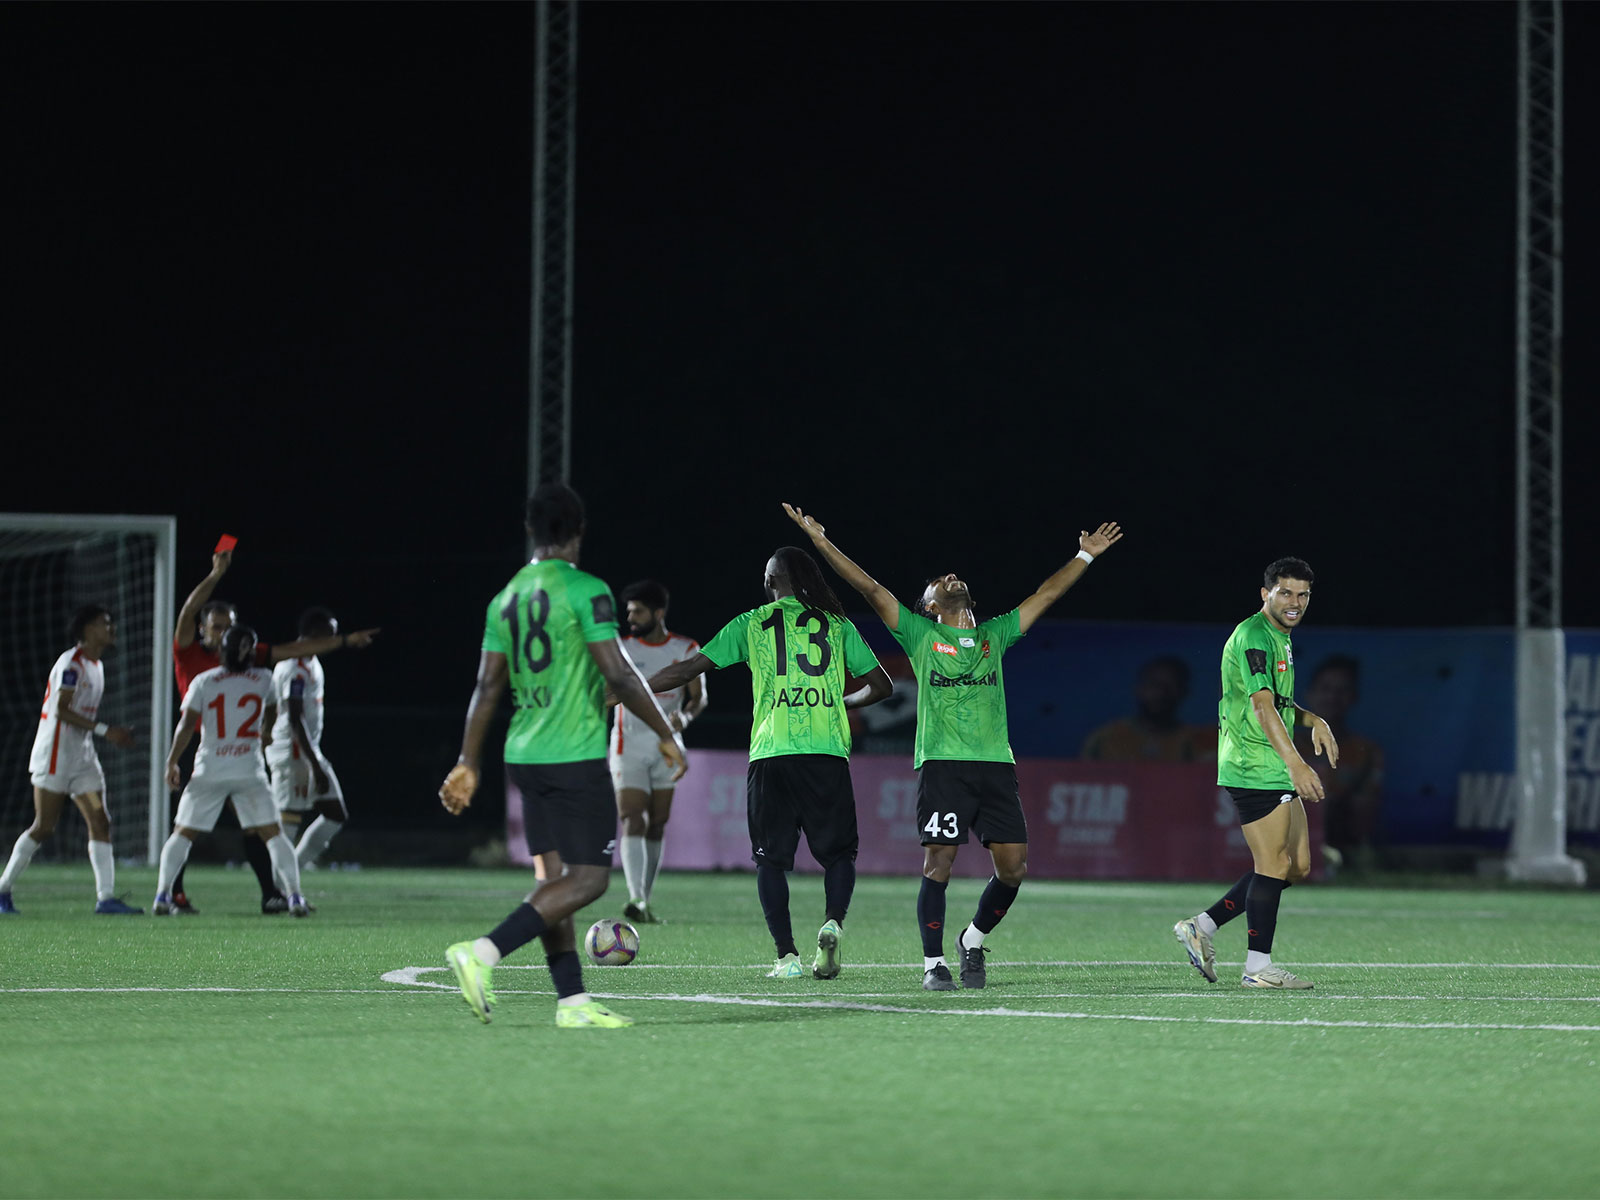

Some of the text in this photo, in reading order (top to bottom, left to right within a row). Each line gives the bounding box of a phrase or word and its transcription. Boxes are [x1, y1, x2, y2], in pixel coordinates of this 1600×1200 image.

[501, 588, 552, 674] 18
[761, 608, 832, 677] 13
[208, 692, 263, 739] 12
[924, 811, 959, 839] 43
[1047, 782, 1129, 825] STAR
